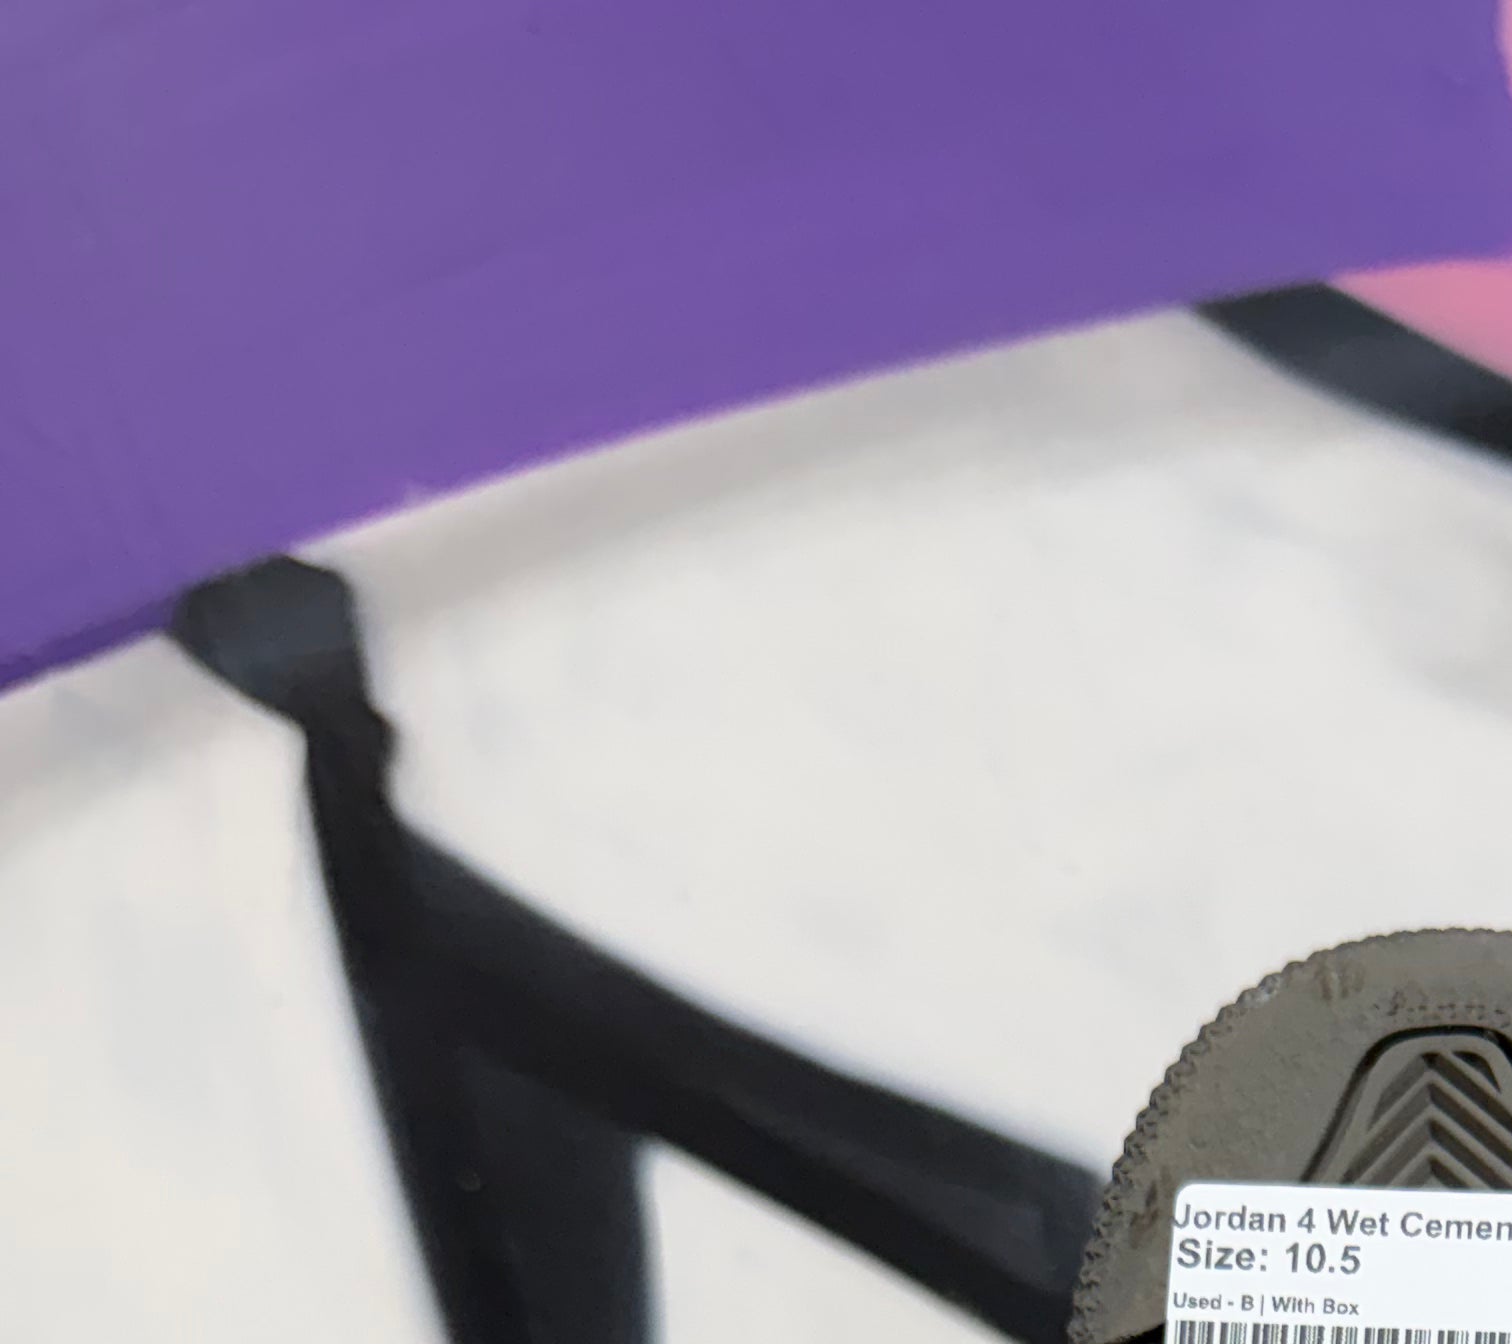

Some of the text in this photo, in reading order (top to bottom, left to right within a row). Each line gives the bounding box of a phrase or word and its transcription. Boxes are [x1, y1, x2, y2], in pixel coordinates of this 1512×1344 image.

[1172, 1203, 1287, 1233] Jordan
[1297, 1207, 1316, 1234] 4
[1327, 1208, 1390, 1237] Wet
[1176, 1238, 1361, 1275] Size: 10.5
[1173, 1292, 1222, 1310] Used
[1241, 1294, 1254, 1311] B
[1271, 1296, 1316, 1315] With
[1322, 1298, 1359, 1315] Box
